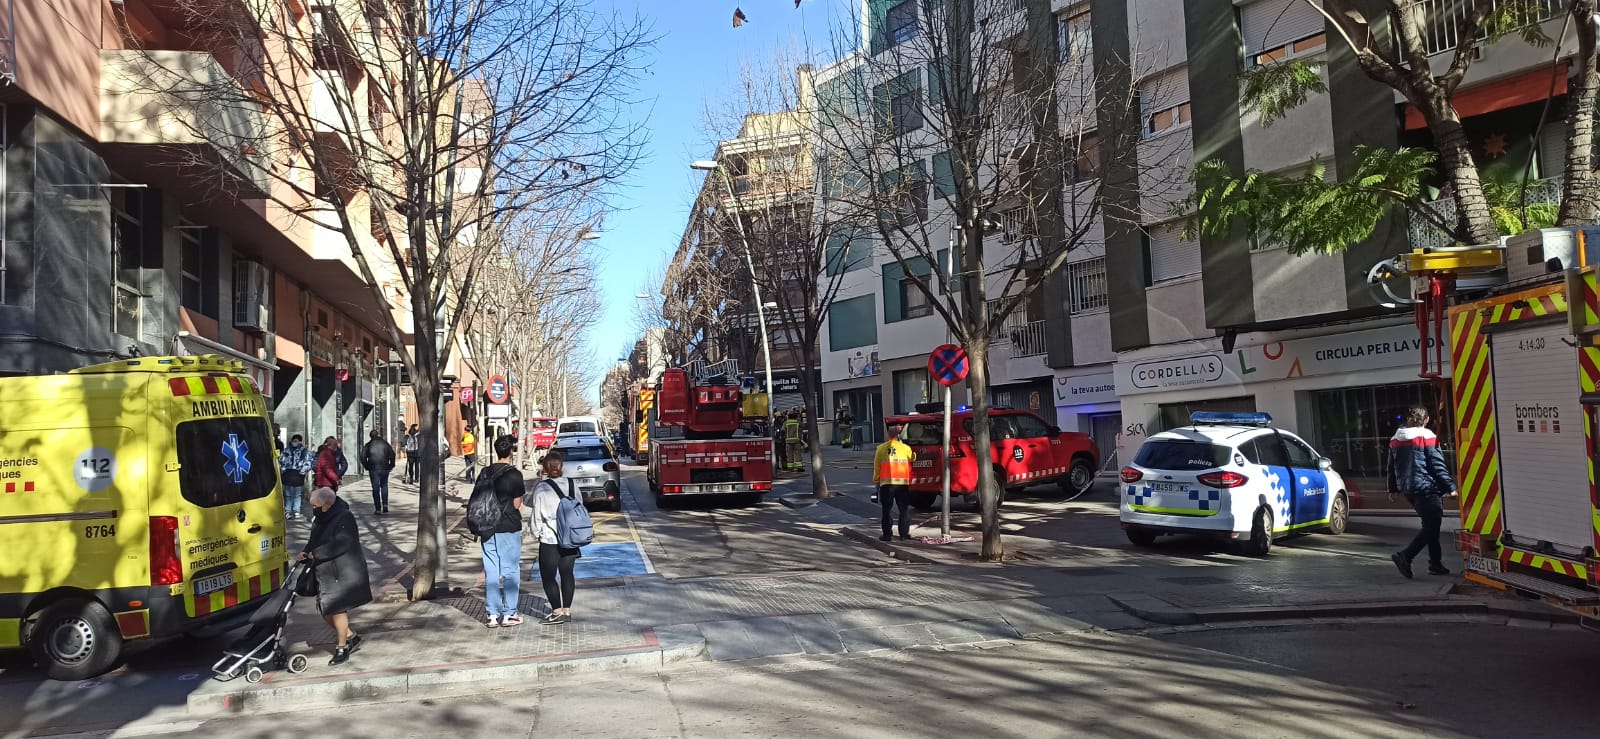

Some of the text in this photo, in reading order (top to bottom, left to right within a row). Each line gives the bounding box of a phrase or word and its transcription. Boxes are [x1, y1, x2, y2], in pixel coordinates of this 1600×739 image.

[1315, 337, 1445, 361] CIRCULA PER LA VD
[1138, 362, 1215, 381] CORDELLAS
[1071, 387, 1078, 395] la
[1079, 386, 1094, 394] teva
[192, 396, 258, 417] AMBULÀNCIA
[1515, 403, 1559, 418] bombers
[81, 458, 110, 474] 112
[0, 470, 21, 480] ues
[85, 524, 116, 538] 8764
[261, 539, 269, 549] 112
